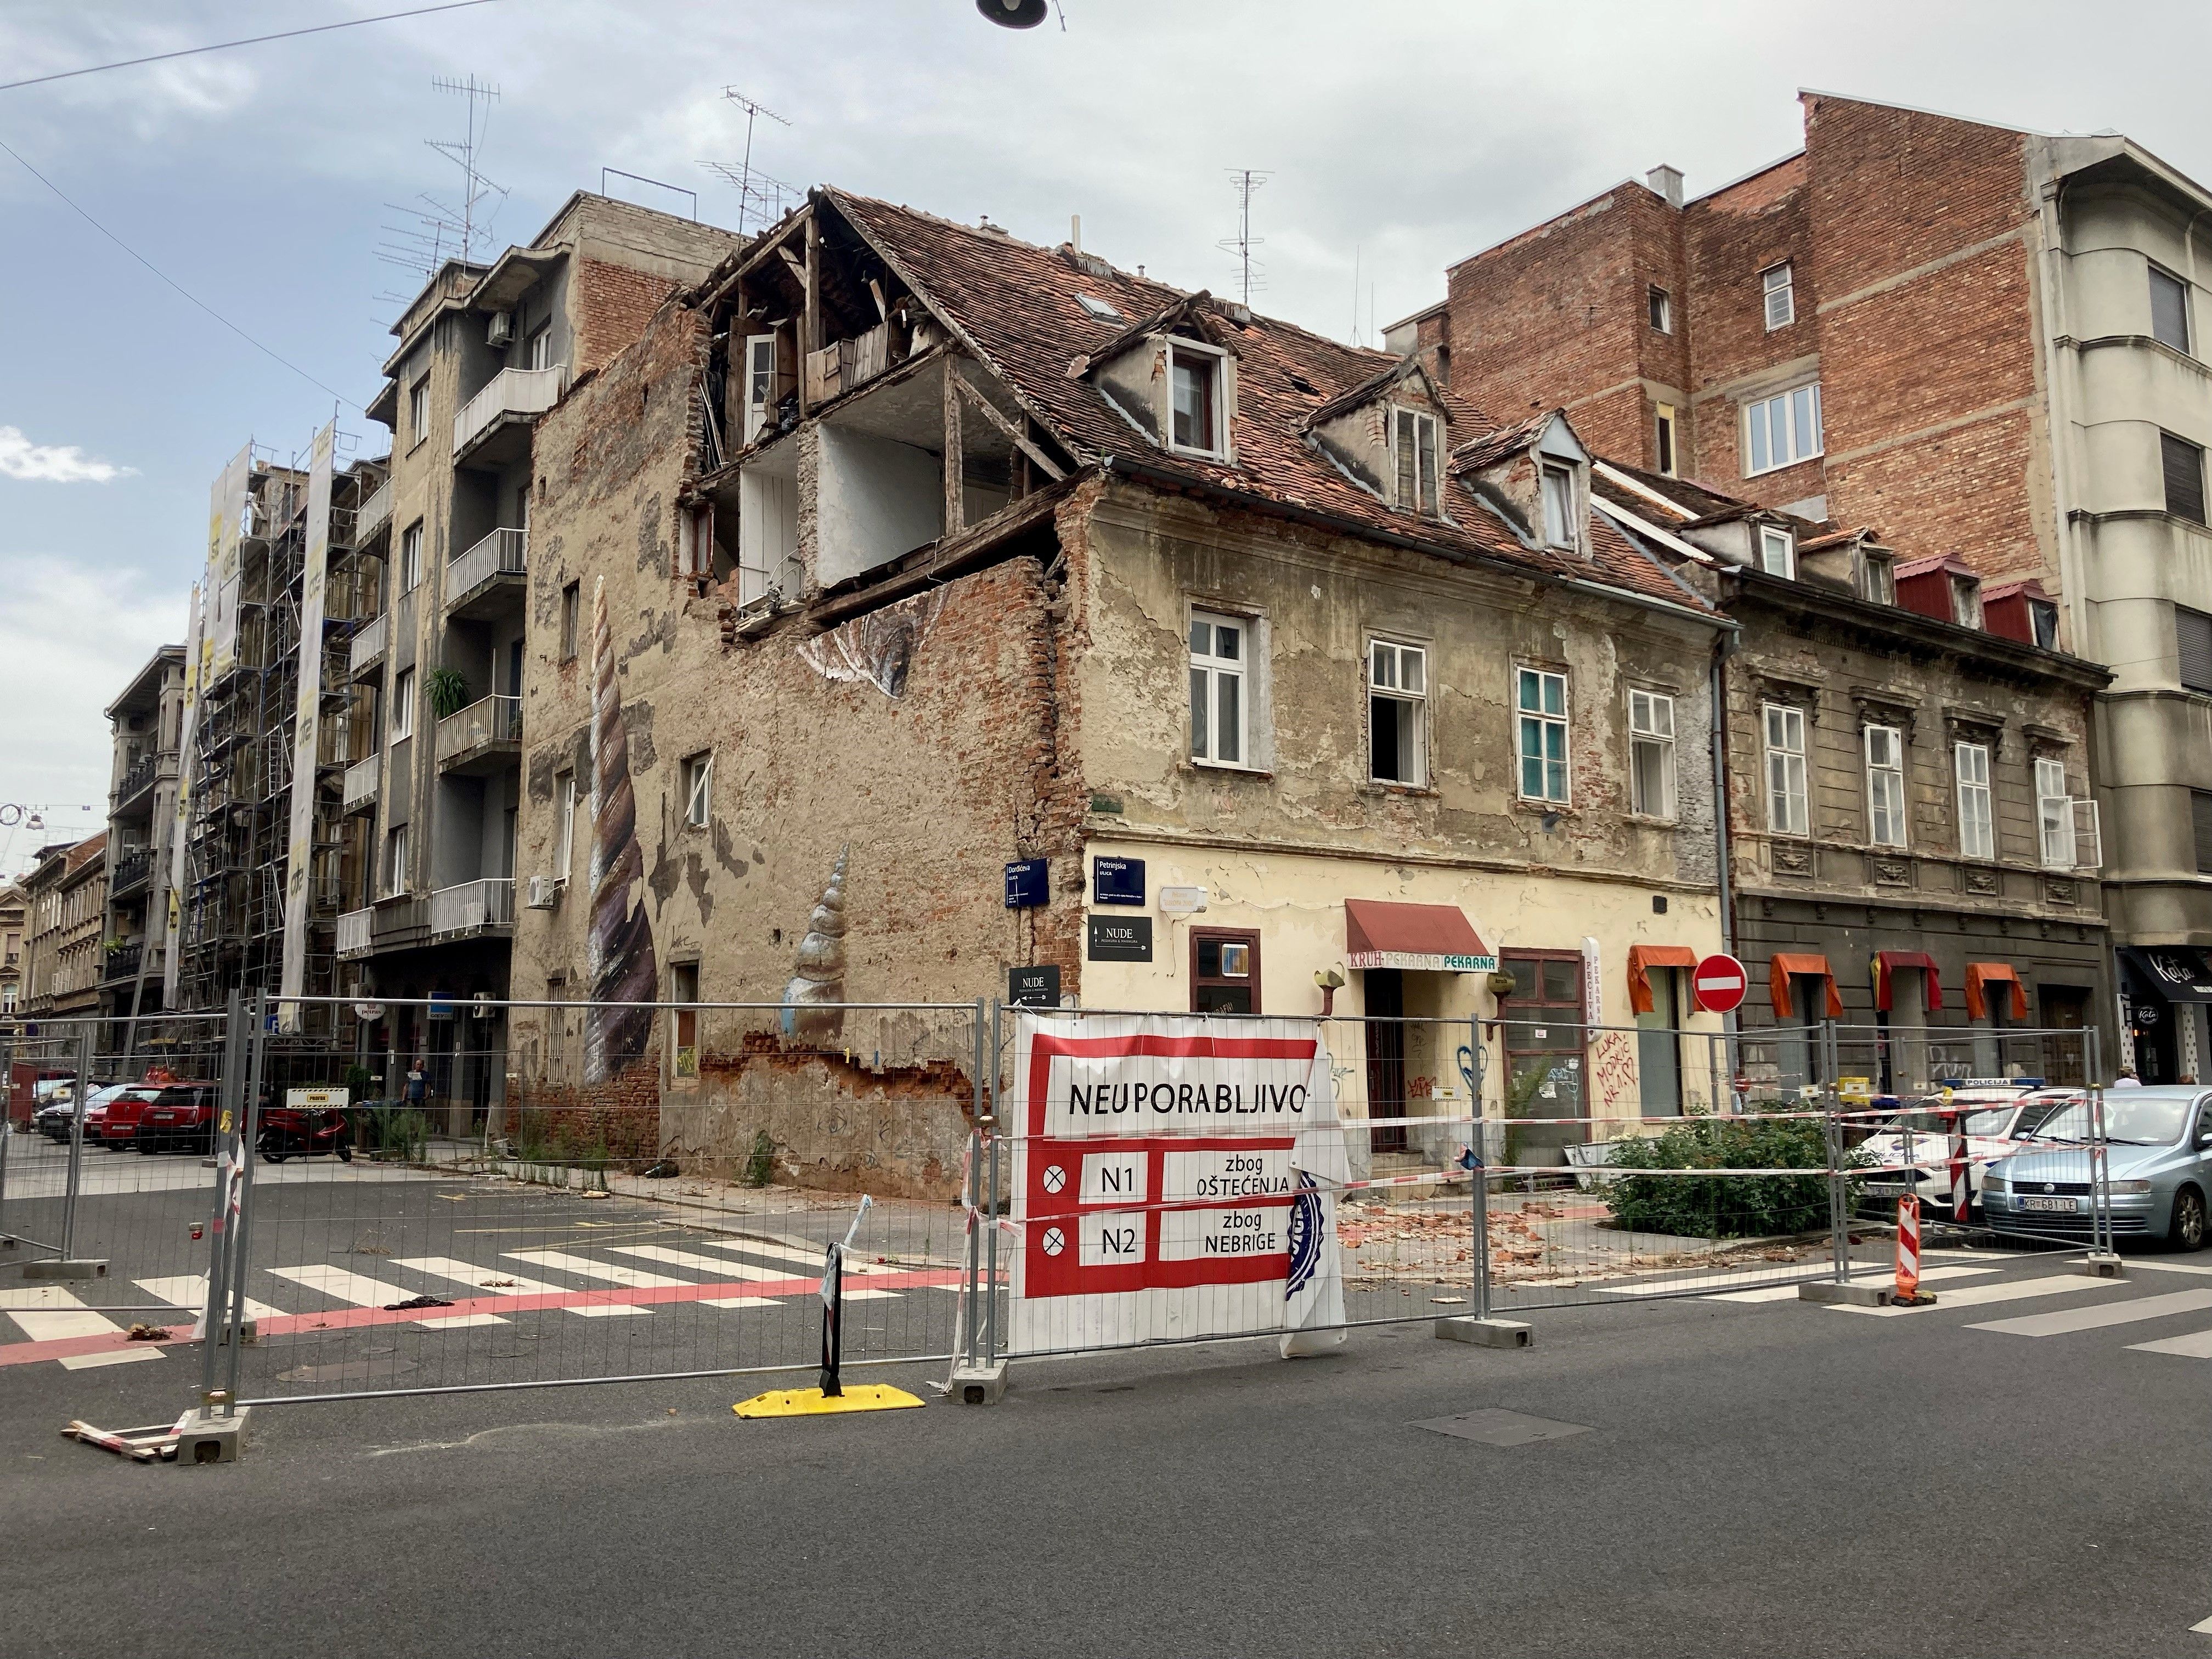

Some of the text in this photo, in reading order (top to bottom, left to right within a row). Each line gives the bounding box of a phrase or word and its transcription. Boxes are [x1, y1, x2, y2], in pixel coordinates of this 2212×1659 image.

[1099, 861, 1126, 871] Petrinjska
[1106, 928, 1133, 939] NUDE
[1350, 951, 1382, 967] KRUH
[1444, 955, 1496, 970] PEKARNA
[2147, 953, 2195, 984] Kata
[1023, 977, 1044, 988] NUDE
[1594, 956, 1602, 1024] PEKARNA
[2139, 1010, 2157, 1019] Kata
[1596, 1031, 1623, 1060] LUKA
[1069, 1082, 1306, 1115] NEUPORABLJIVO
[1225, 1154, 1263, 1176] zbog
[1101, 1167, 1134, 1193] N1
[1197, 1174, 1289, 1197] OŠTEĆENJA
[2025, 1199, 2035, 1209] KR
[1222, 1210, 1262, 1231] zbog
[1102, 1228, 1136, 1254] N2
[1205, 1233, 1276, 1253] NEBRIGE
